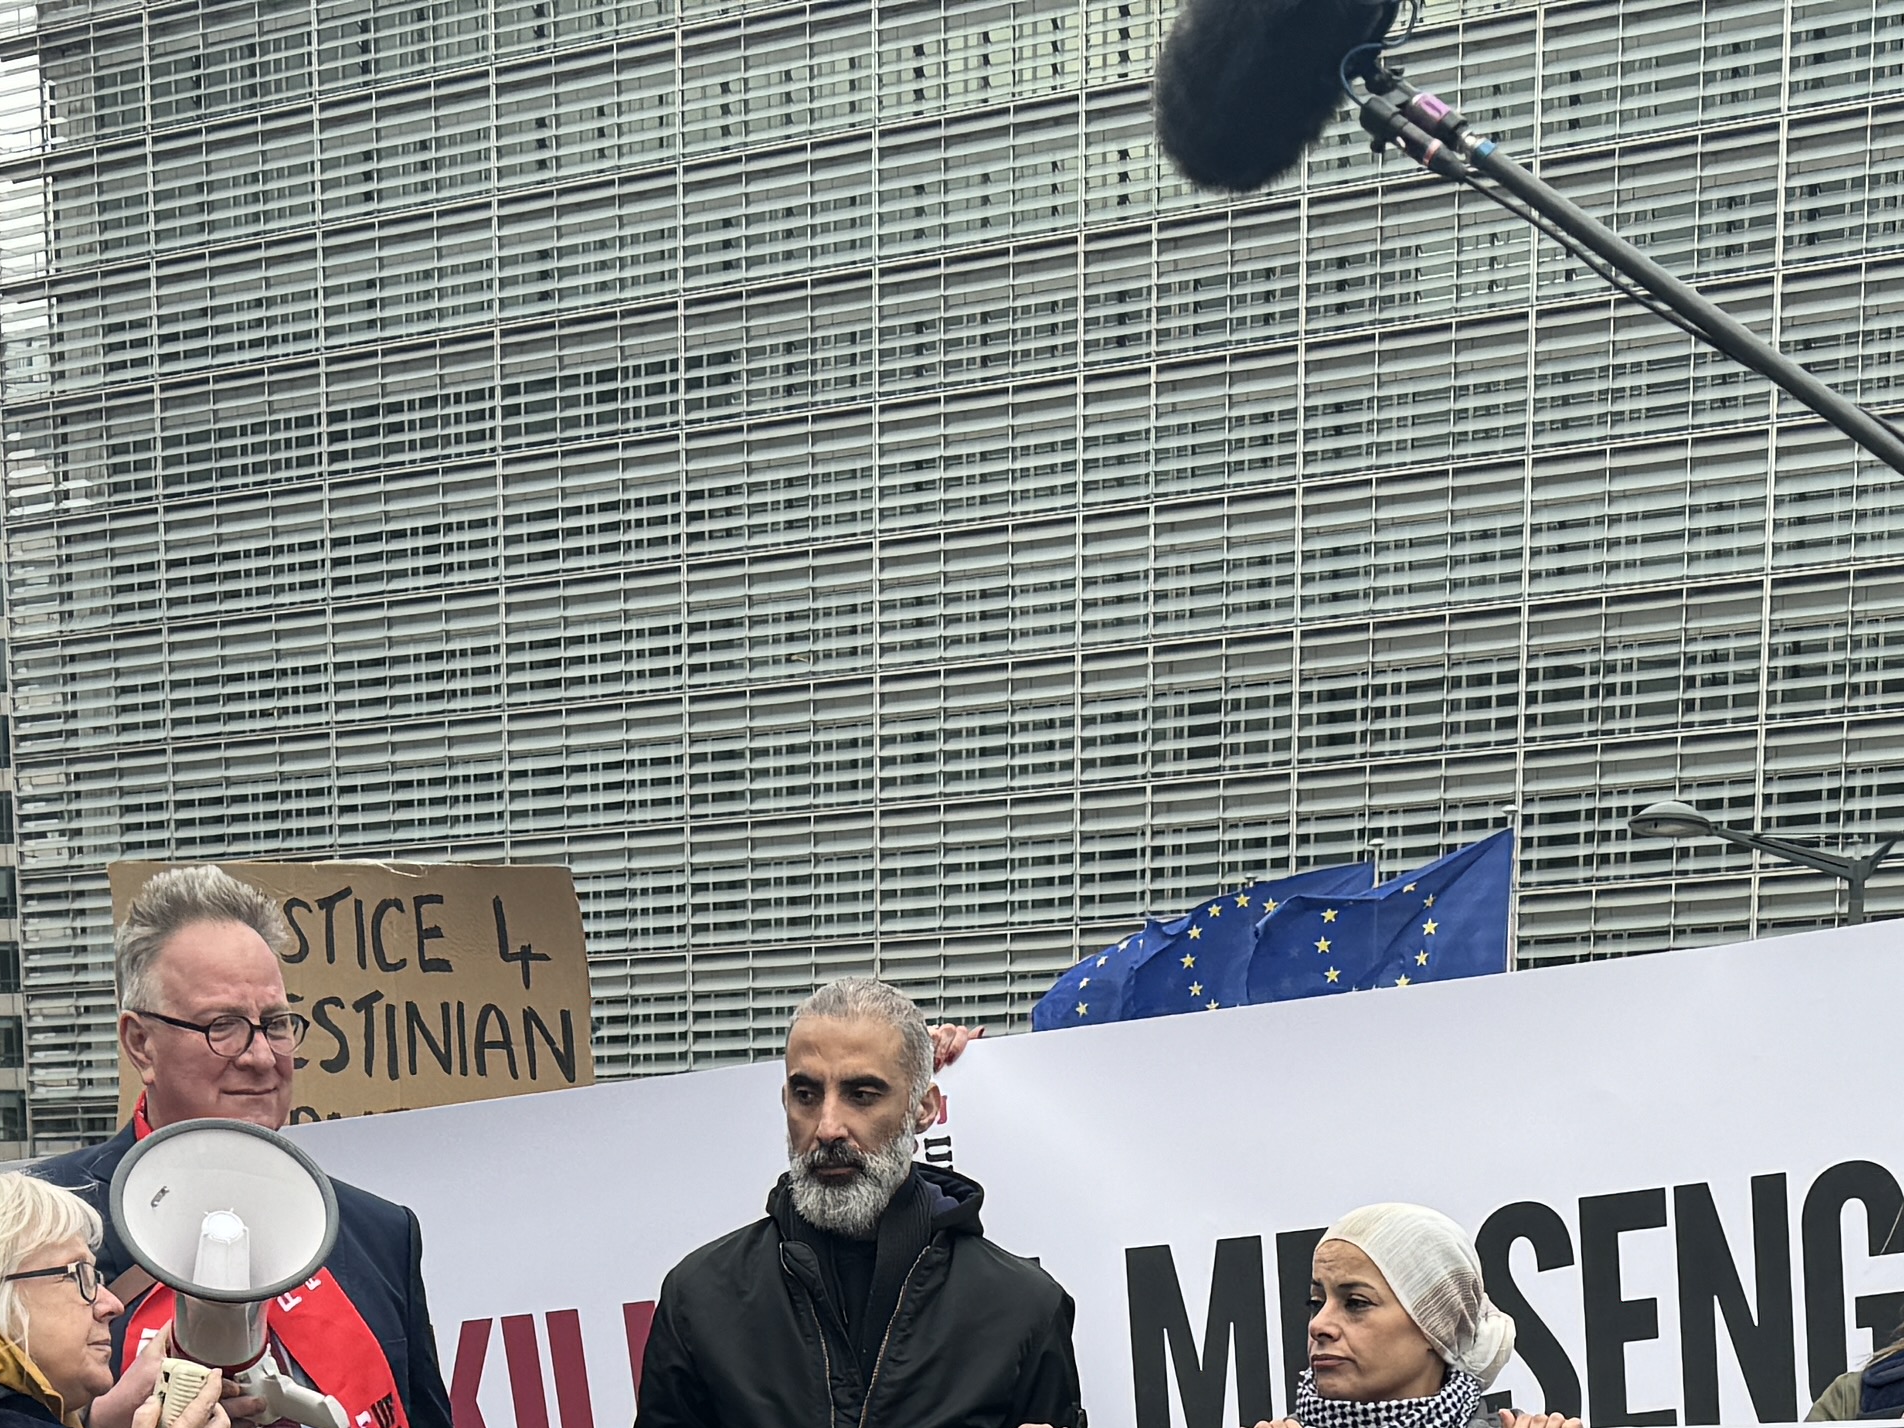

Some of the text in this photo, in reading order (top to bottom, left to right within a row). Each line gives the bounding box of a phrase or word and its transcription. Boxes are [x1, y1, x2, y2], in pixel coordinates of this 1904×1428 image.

[281, 886, 553, 990] STICE 4
[287, 989, 577, 1083] STINIAN
